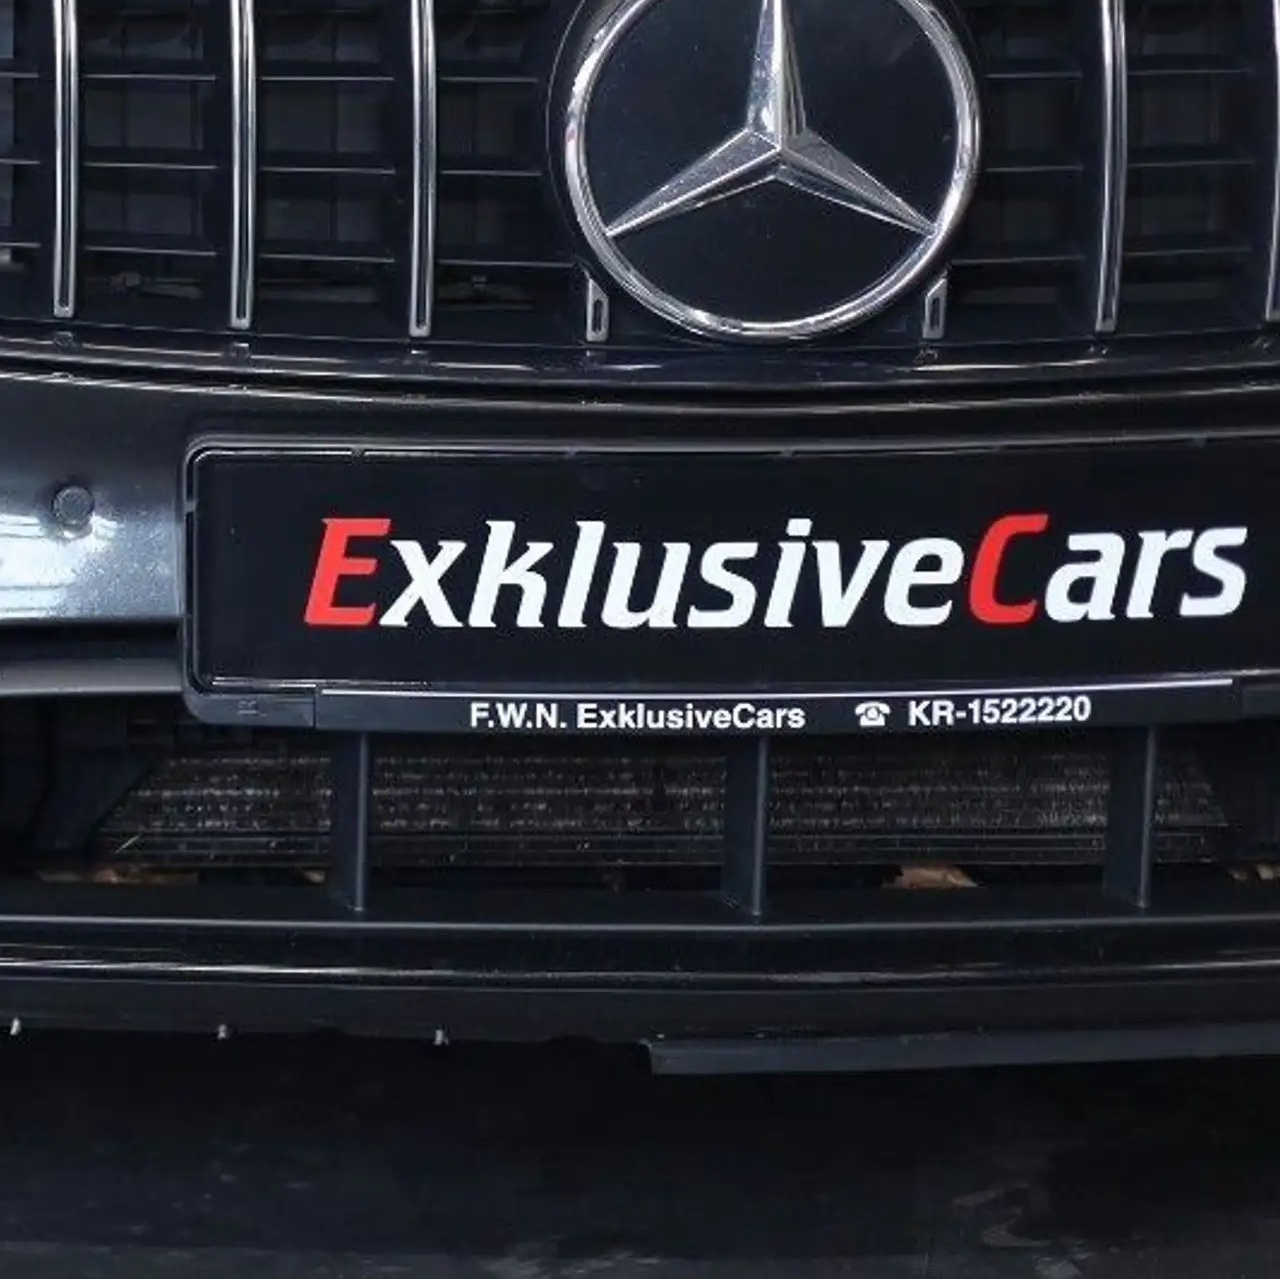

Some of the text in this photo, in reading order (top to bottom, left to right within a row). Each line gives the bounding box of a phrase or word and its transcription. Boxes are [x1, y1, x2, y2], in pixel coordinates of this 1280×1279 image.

[303, 513, 1249, 629] ExklusiveCars
[469, 695, 1092, 730] F.W.N. ExklusiveCars KR-1522220
